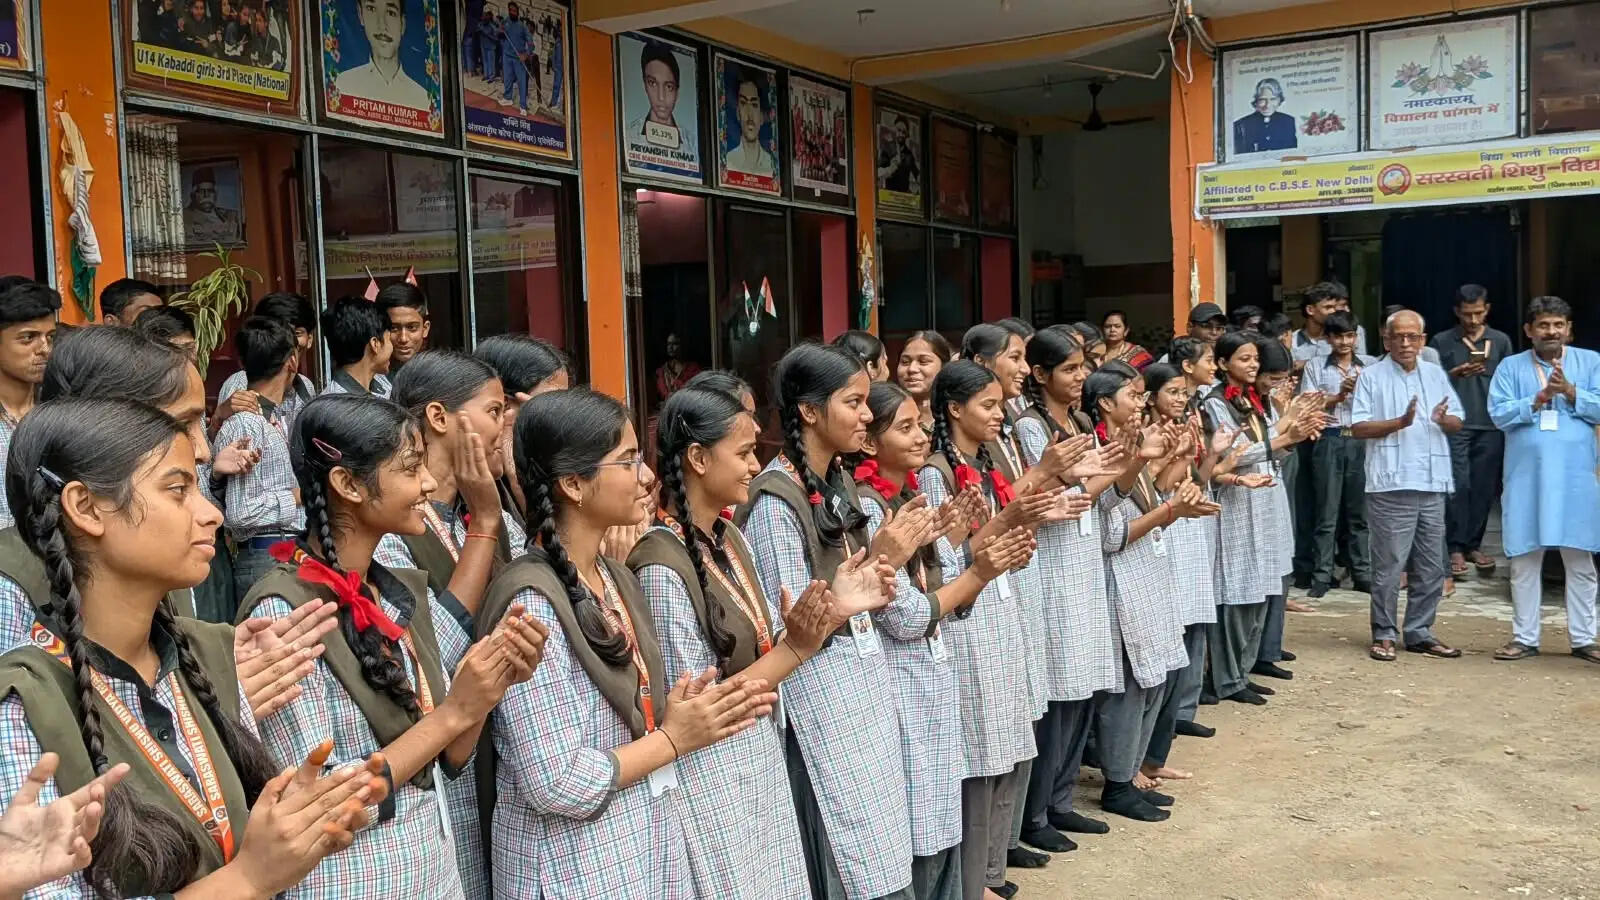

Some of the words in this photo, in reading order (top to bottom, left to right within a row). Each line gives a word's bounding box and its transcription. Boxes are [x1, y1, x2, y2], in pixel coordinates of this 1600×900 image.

[136, 49, 156, 66] U14
[157, 53, 195, 73] Kabaddi
[196, 63, 216, 79] girls
[216, 65, 231, 82] 3rd
[232, 69, 253, 86] Place
[253, 71, 289, 97] (National)
[353, 98, 386, 114] PRITAM
[387, 104, 418, 120] KUMAR
[631, 143, 669, 157] PRIYANSHU
[670, 151, 695, 162] KUMAR
[1203, 184, 1252, 196] Affiliated
[1254, 183, 1266, 192] to
[1268, 179, 1312, 191] C.B.S.E.
[1315, 178, 1341, 188] New
[1344, 175, 1373, 186] Delhi
[1415, 164, 1494, 186] सरस्वती
[104, 692, 133, 725] VIDYA
[176, 694, 198, 736] SHISHU
[128, 722, 164, 763] SHISHU
[189, 735, 222, 802] SARASWATI
[159, 759, 210, 818] SARASWATI
